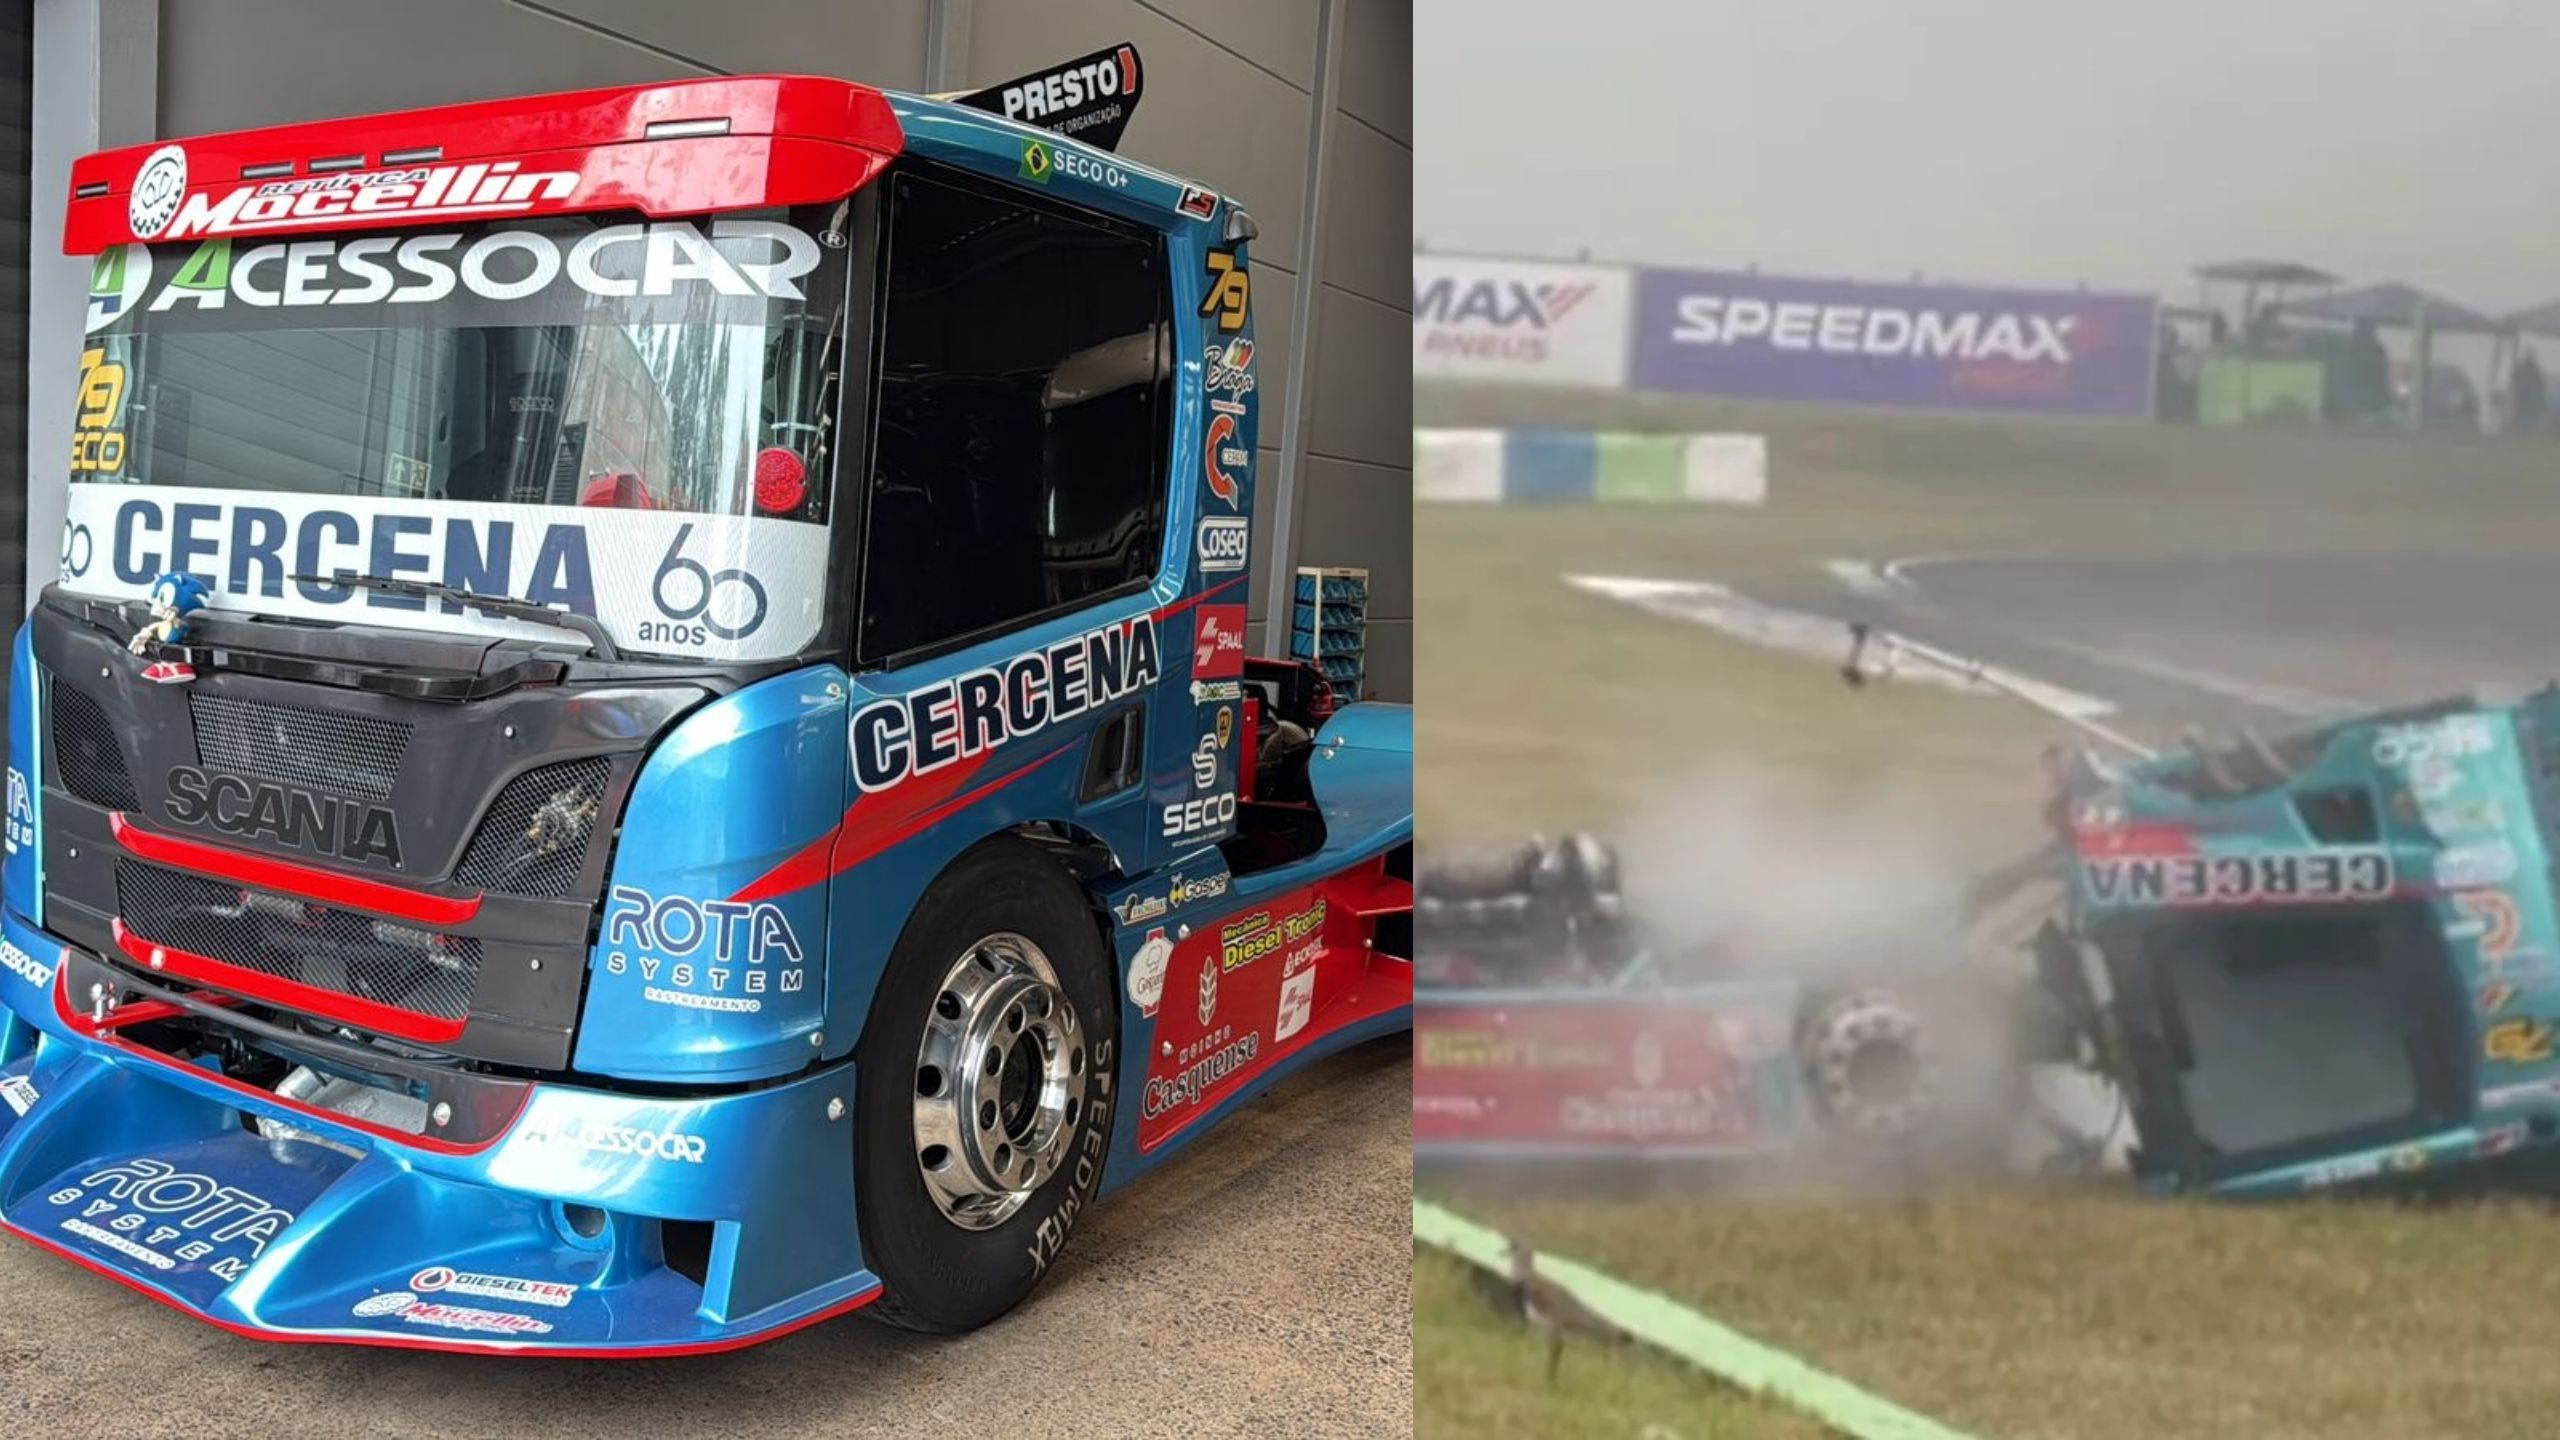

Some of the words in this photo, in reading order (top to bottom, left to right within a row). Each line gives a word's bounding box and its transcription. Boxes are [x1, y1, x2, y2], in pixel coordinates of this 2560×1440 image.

[1002, 59, 1118, 121] PRESTO
[164, 160, 581, 239] Mocellin
[1053, 149, 1102, 183] SECO
[1106, 167, 1129, 188] O+
[148, 220, 822, 311] ACESSOCAR
[1199, 248, 1249, 332] 79
[1672, 292, 2078, 363] SPEEDMAX
[70, 431, 125, 474] ECO
[113, 499, 597, 620] CERCENA
[653, 523, 767, 640] 60
[639, 619, 706, 646] anos
[850, 613, 1161, 793] CERCENA
[164, 765, 405, 870] SCANIA
[1163, 792, 1235, 836] SECO
[2086, 850, 2392, 900] CERCENA
[610, 885, 803, 962] ROTA
[1224, 925, 1282, 972] Diesel
[1286, 900, 1326, 942] Tronic
[608, 952, 803, 992] SYSTEM
[645, 987, 761, 1012] RASTREAMENTO
[1143, 1031, 1259, 1120] Casquense
[49, 1188, 248, 1282] SYSTEM
[82, 1158, 294, 1259] ROTA
[455, 1273, 572, 1298] DIESELTEK
